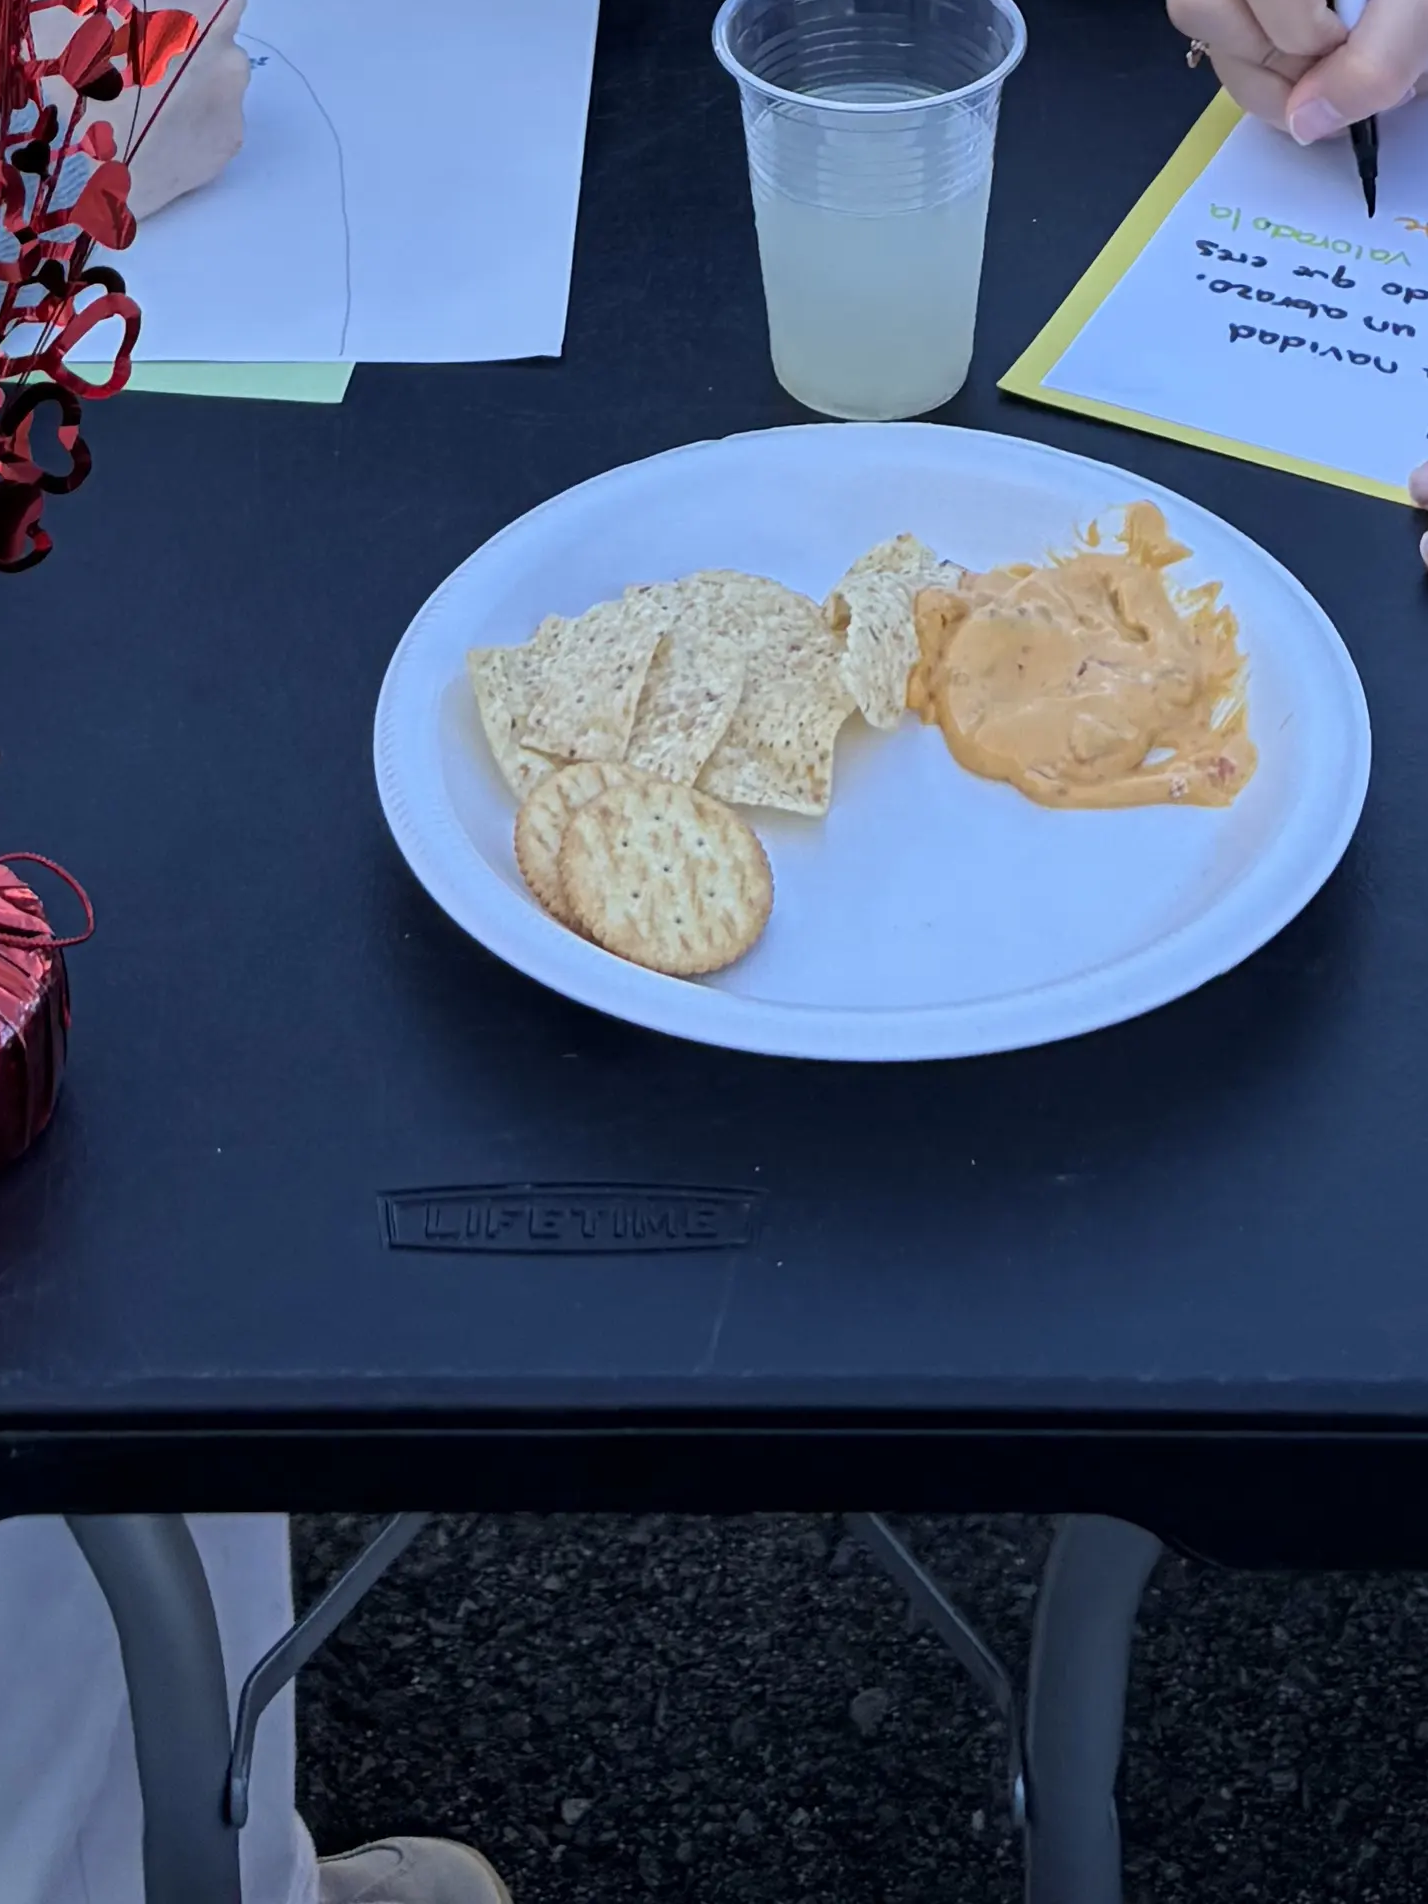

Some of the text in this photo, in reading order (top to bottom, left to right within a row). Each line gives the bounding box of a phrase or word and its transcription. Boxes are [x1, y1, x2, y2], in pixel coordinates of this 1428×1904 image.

[1196, 240, 1267, 267] eres
[1293, 265, 1356, 288] que
[1196, 273, 1348, 319] abrazo.
[1363, 315, 1415, 337] un
[1229, 323, 1399, 374] navidad
[424, 1202, 720, 1240] LIFETIME
